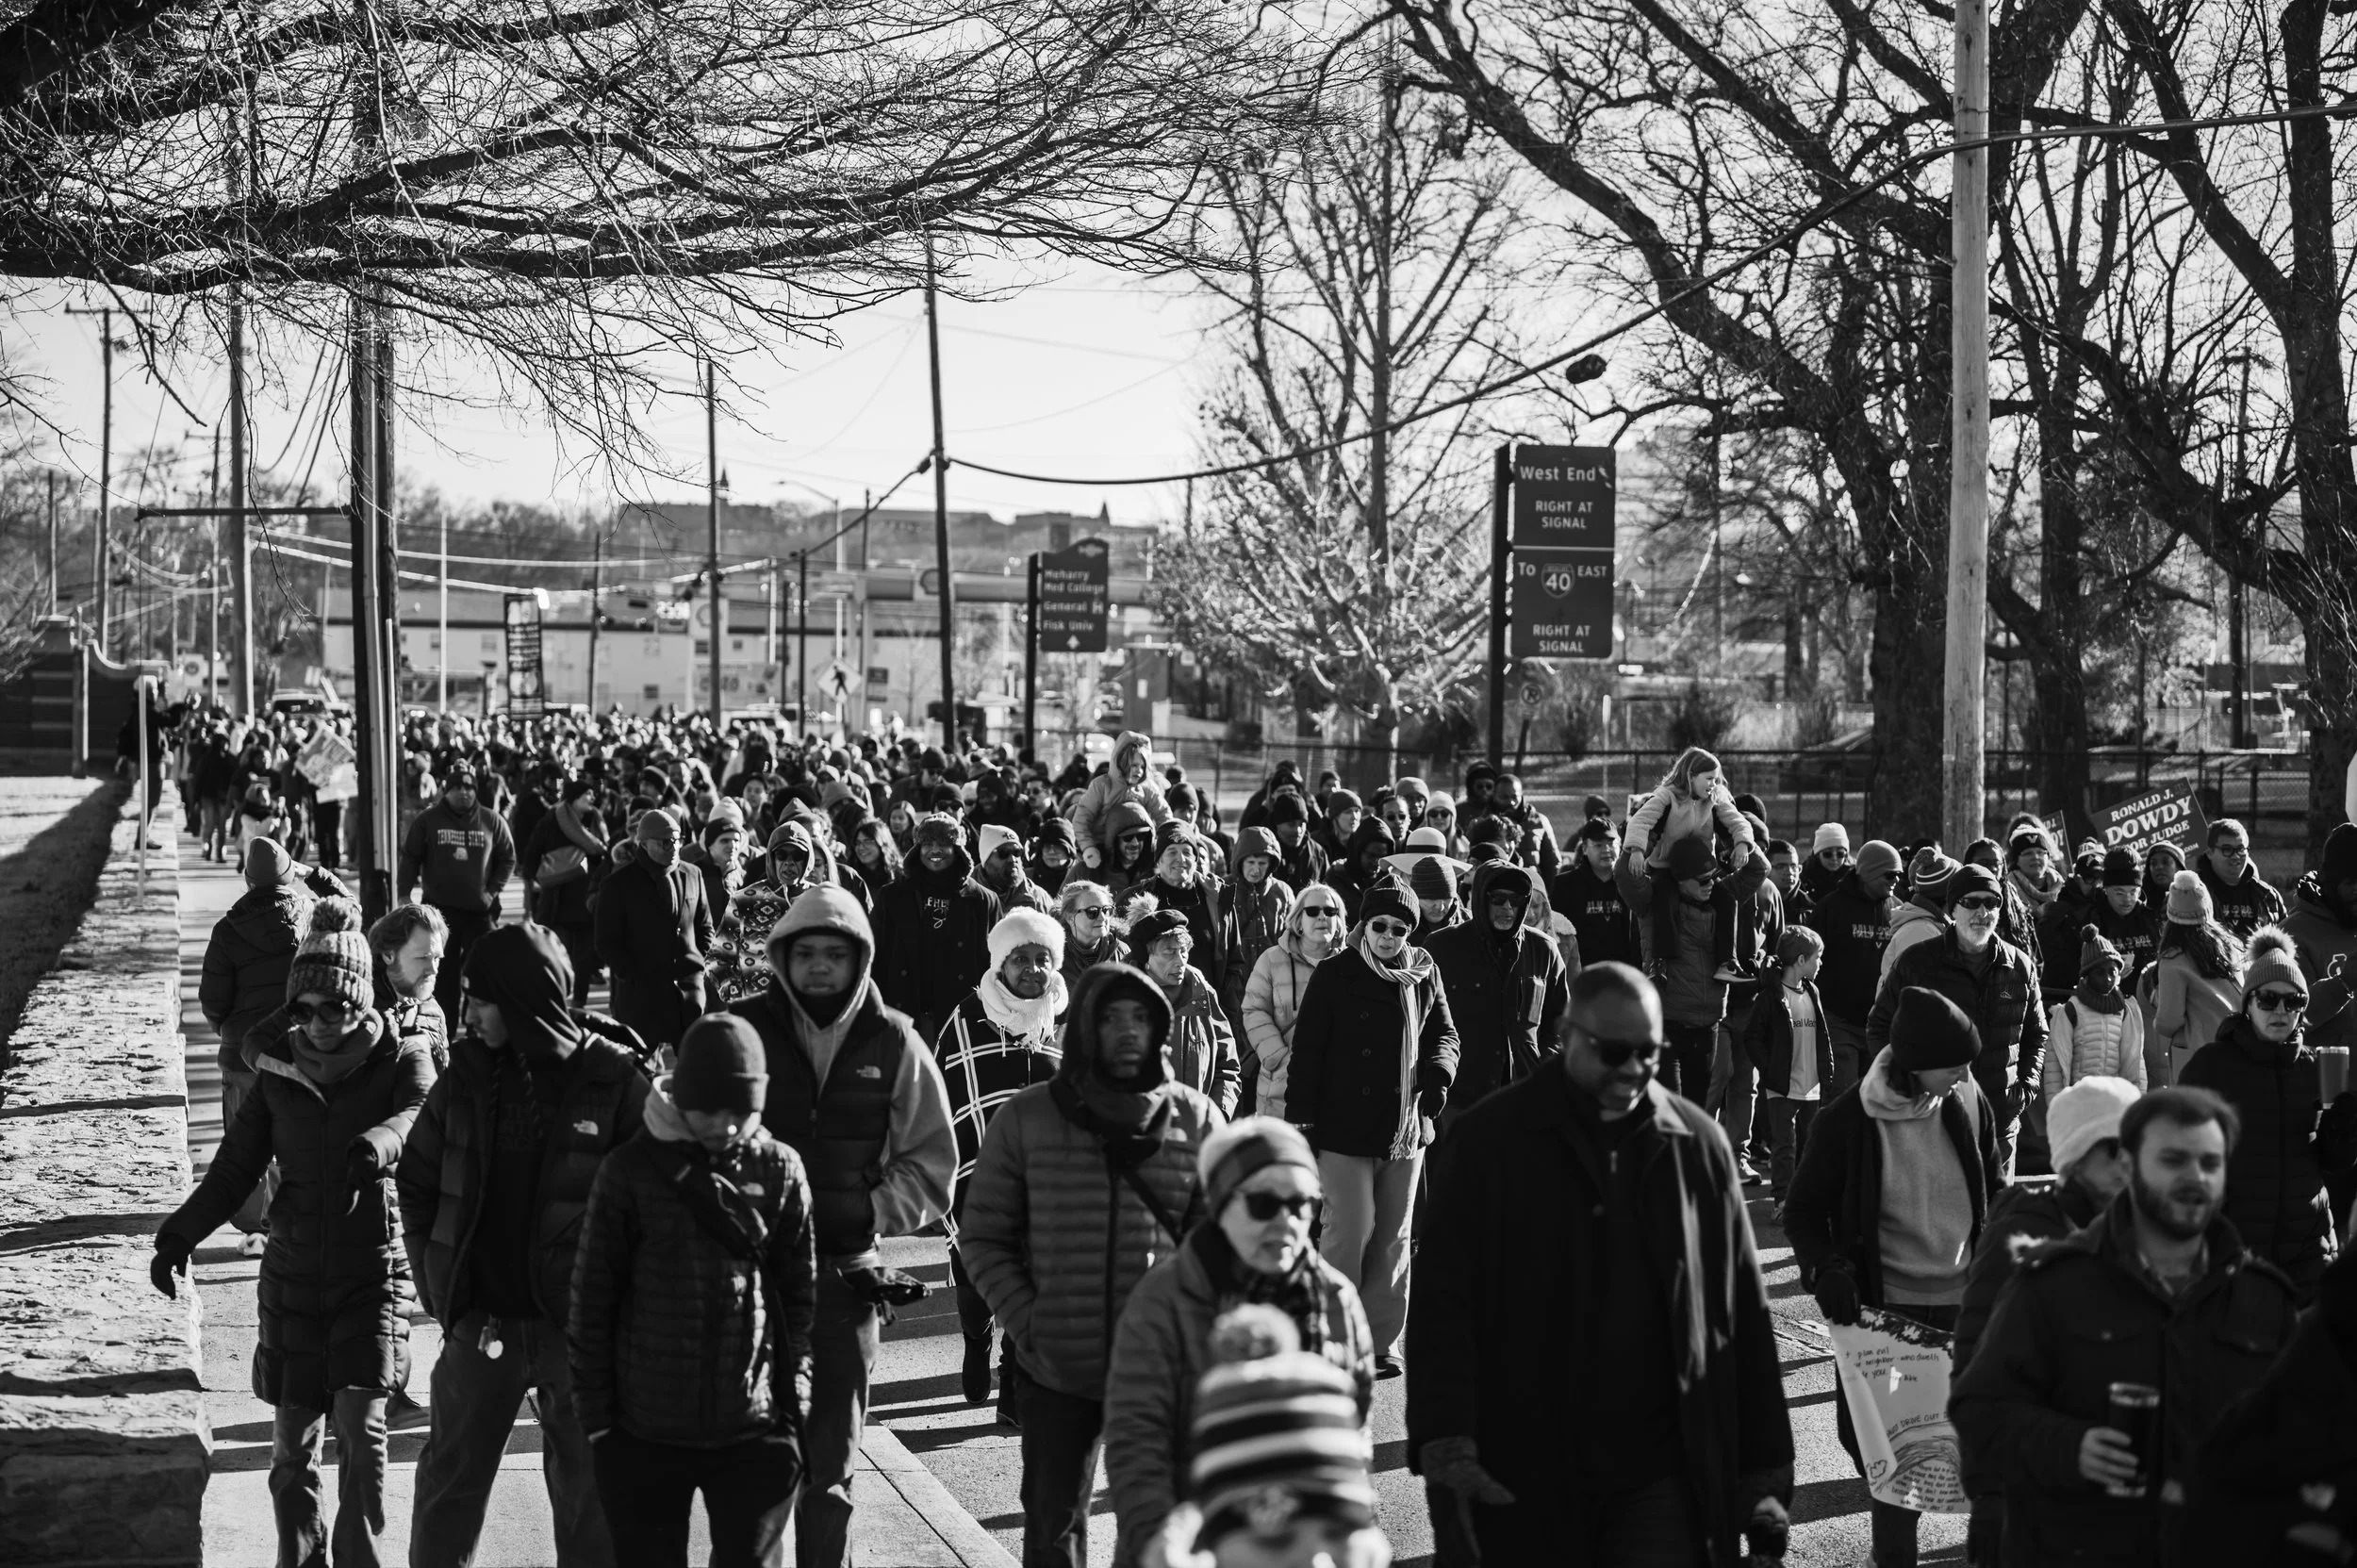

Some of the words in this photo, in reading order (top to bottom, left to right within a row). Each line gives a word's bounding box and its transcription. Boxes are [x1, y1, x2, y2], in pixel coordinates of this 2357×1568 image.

[1520, 466, 1559, 481] West
[1567, 466, 1596, 482] End
[1535, 500, 1573, 513] RIGHT
[1578, 501, 1593, 513] AT
[1541, 517, 1587, 529] SIGNAL
[1044, 569, 1091, 584] Meharry
[1518, 562, 1537, 577] To
[1544, 573, 1571, 591] 40
[1577, 565, 1607, 578] EAST
[1044, 583, 1064, 593] Med
[1067, 583, 1105, 595] College
[1043, 601, 1088, 613] General
[1043, 620, 1064, 631] Fisk
[1069, 620, 1095, 632] Univ
[1533, 624, 1570, 636] RIGHT
[1574, 624, 1591, 637] AT
[1539, 640, 1584, 652] SIGNAL
[2110, 794, 2161, 822] RONALD
[2163, 788, 2174, 800] J.
[2104, 795, 2192, 847] DOWDY
[437, 828, 466, 847] TENNESSEE
[468, 830, 485, 847] STATE
[2129, 837, 2149, 851] OR
[2150, 820, 2190, 845] JUDGE
[1876, 1346, 1889, 1355] evil
[1901, 1414, 1921, 1428] DRIVE
[1923, 1412, 1939, 1422] OUT
